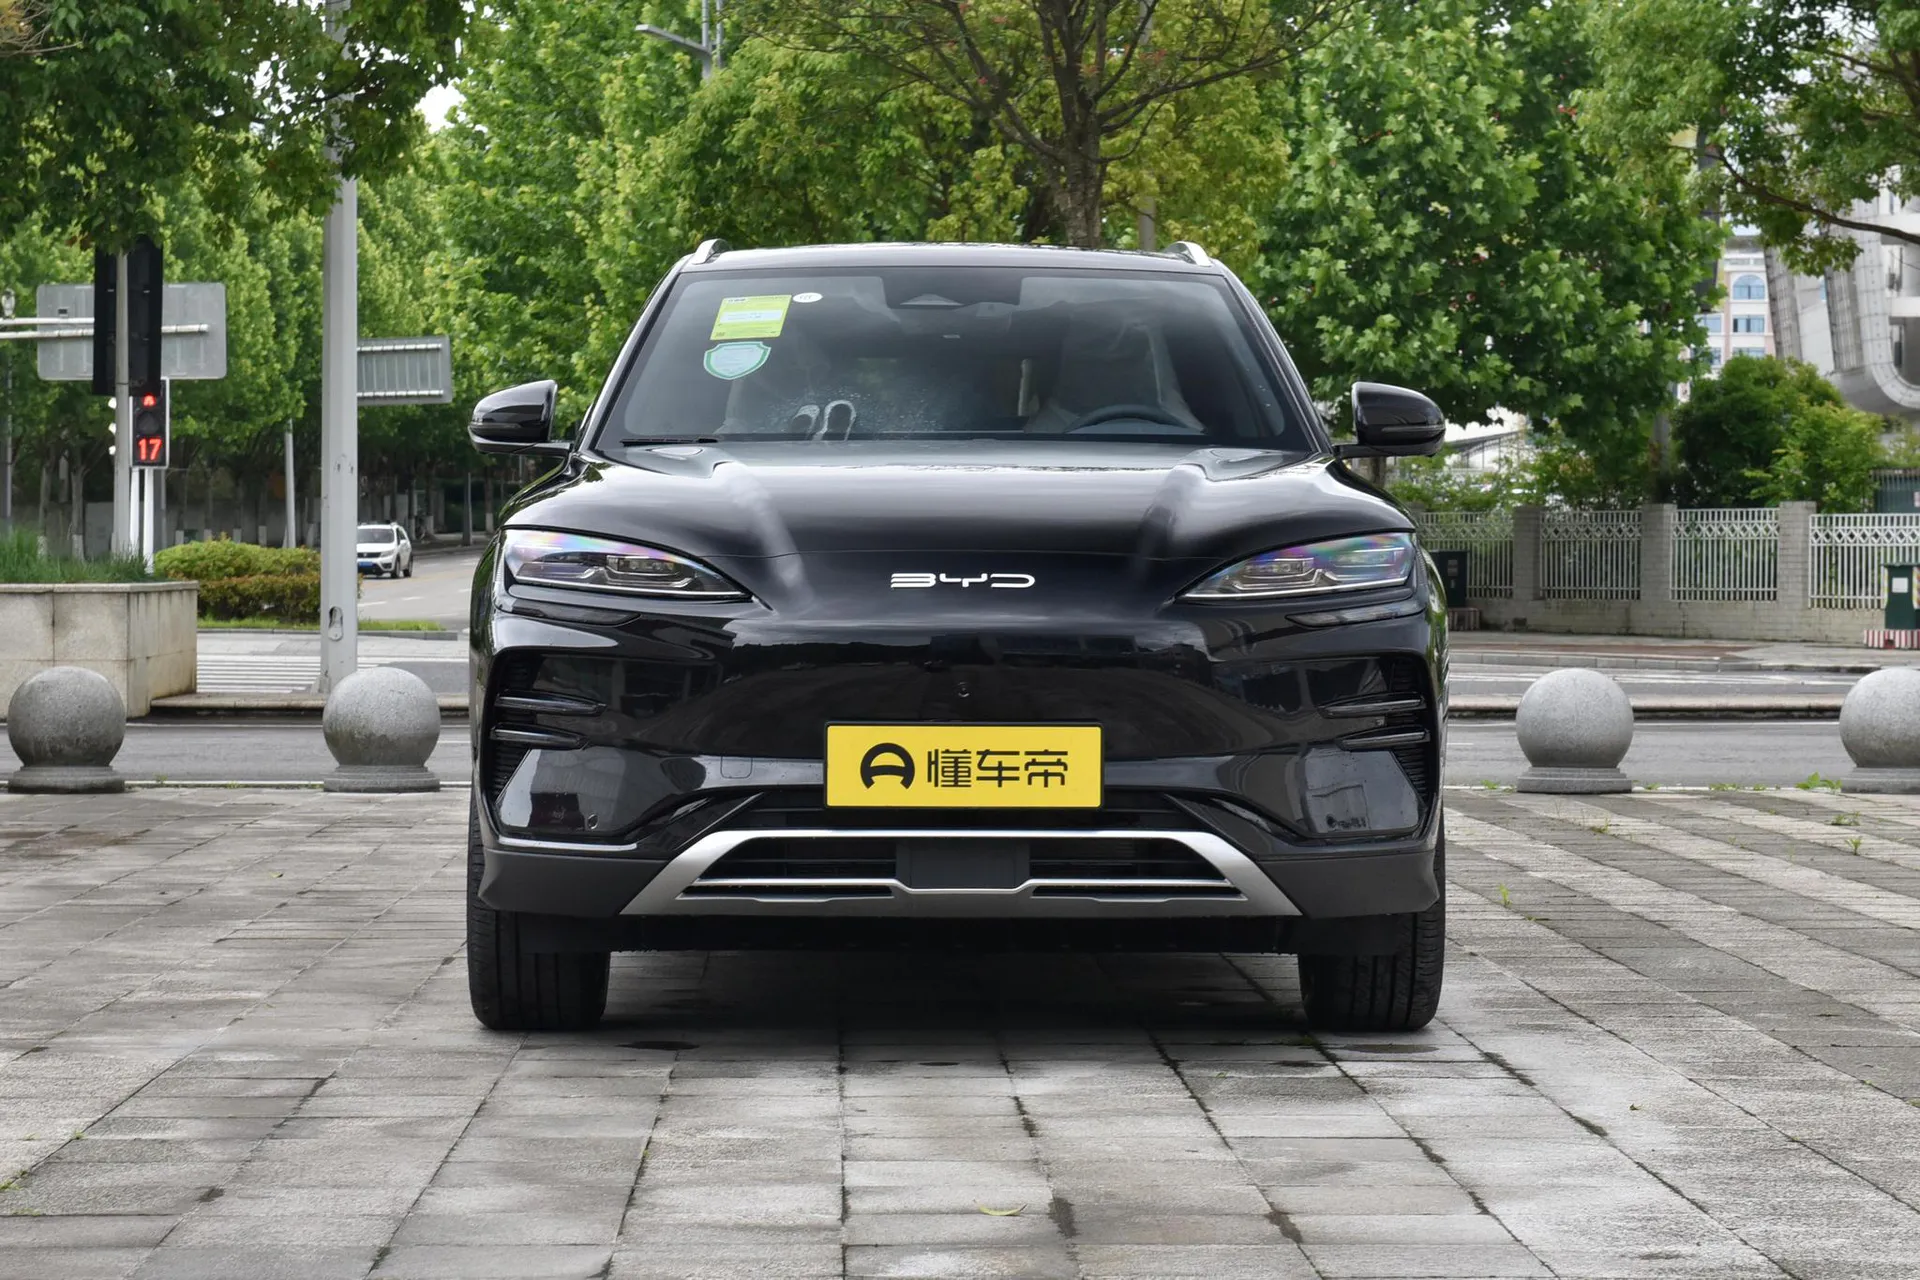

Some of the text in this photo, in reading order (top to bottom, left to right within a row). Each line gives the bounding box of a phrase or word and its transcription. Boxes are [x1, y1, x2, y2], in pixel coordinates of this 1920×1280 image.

[138, 438, 162, 461] 17
[890, 572, 1036, 588] BYD
[927, 748, 1069, 788] 懂车帝
